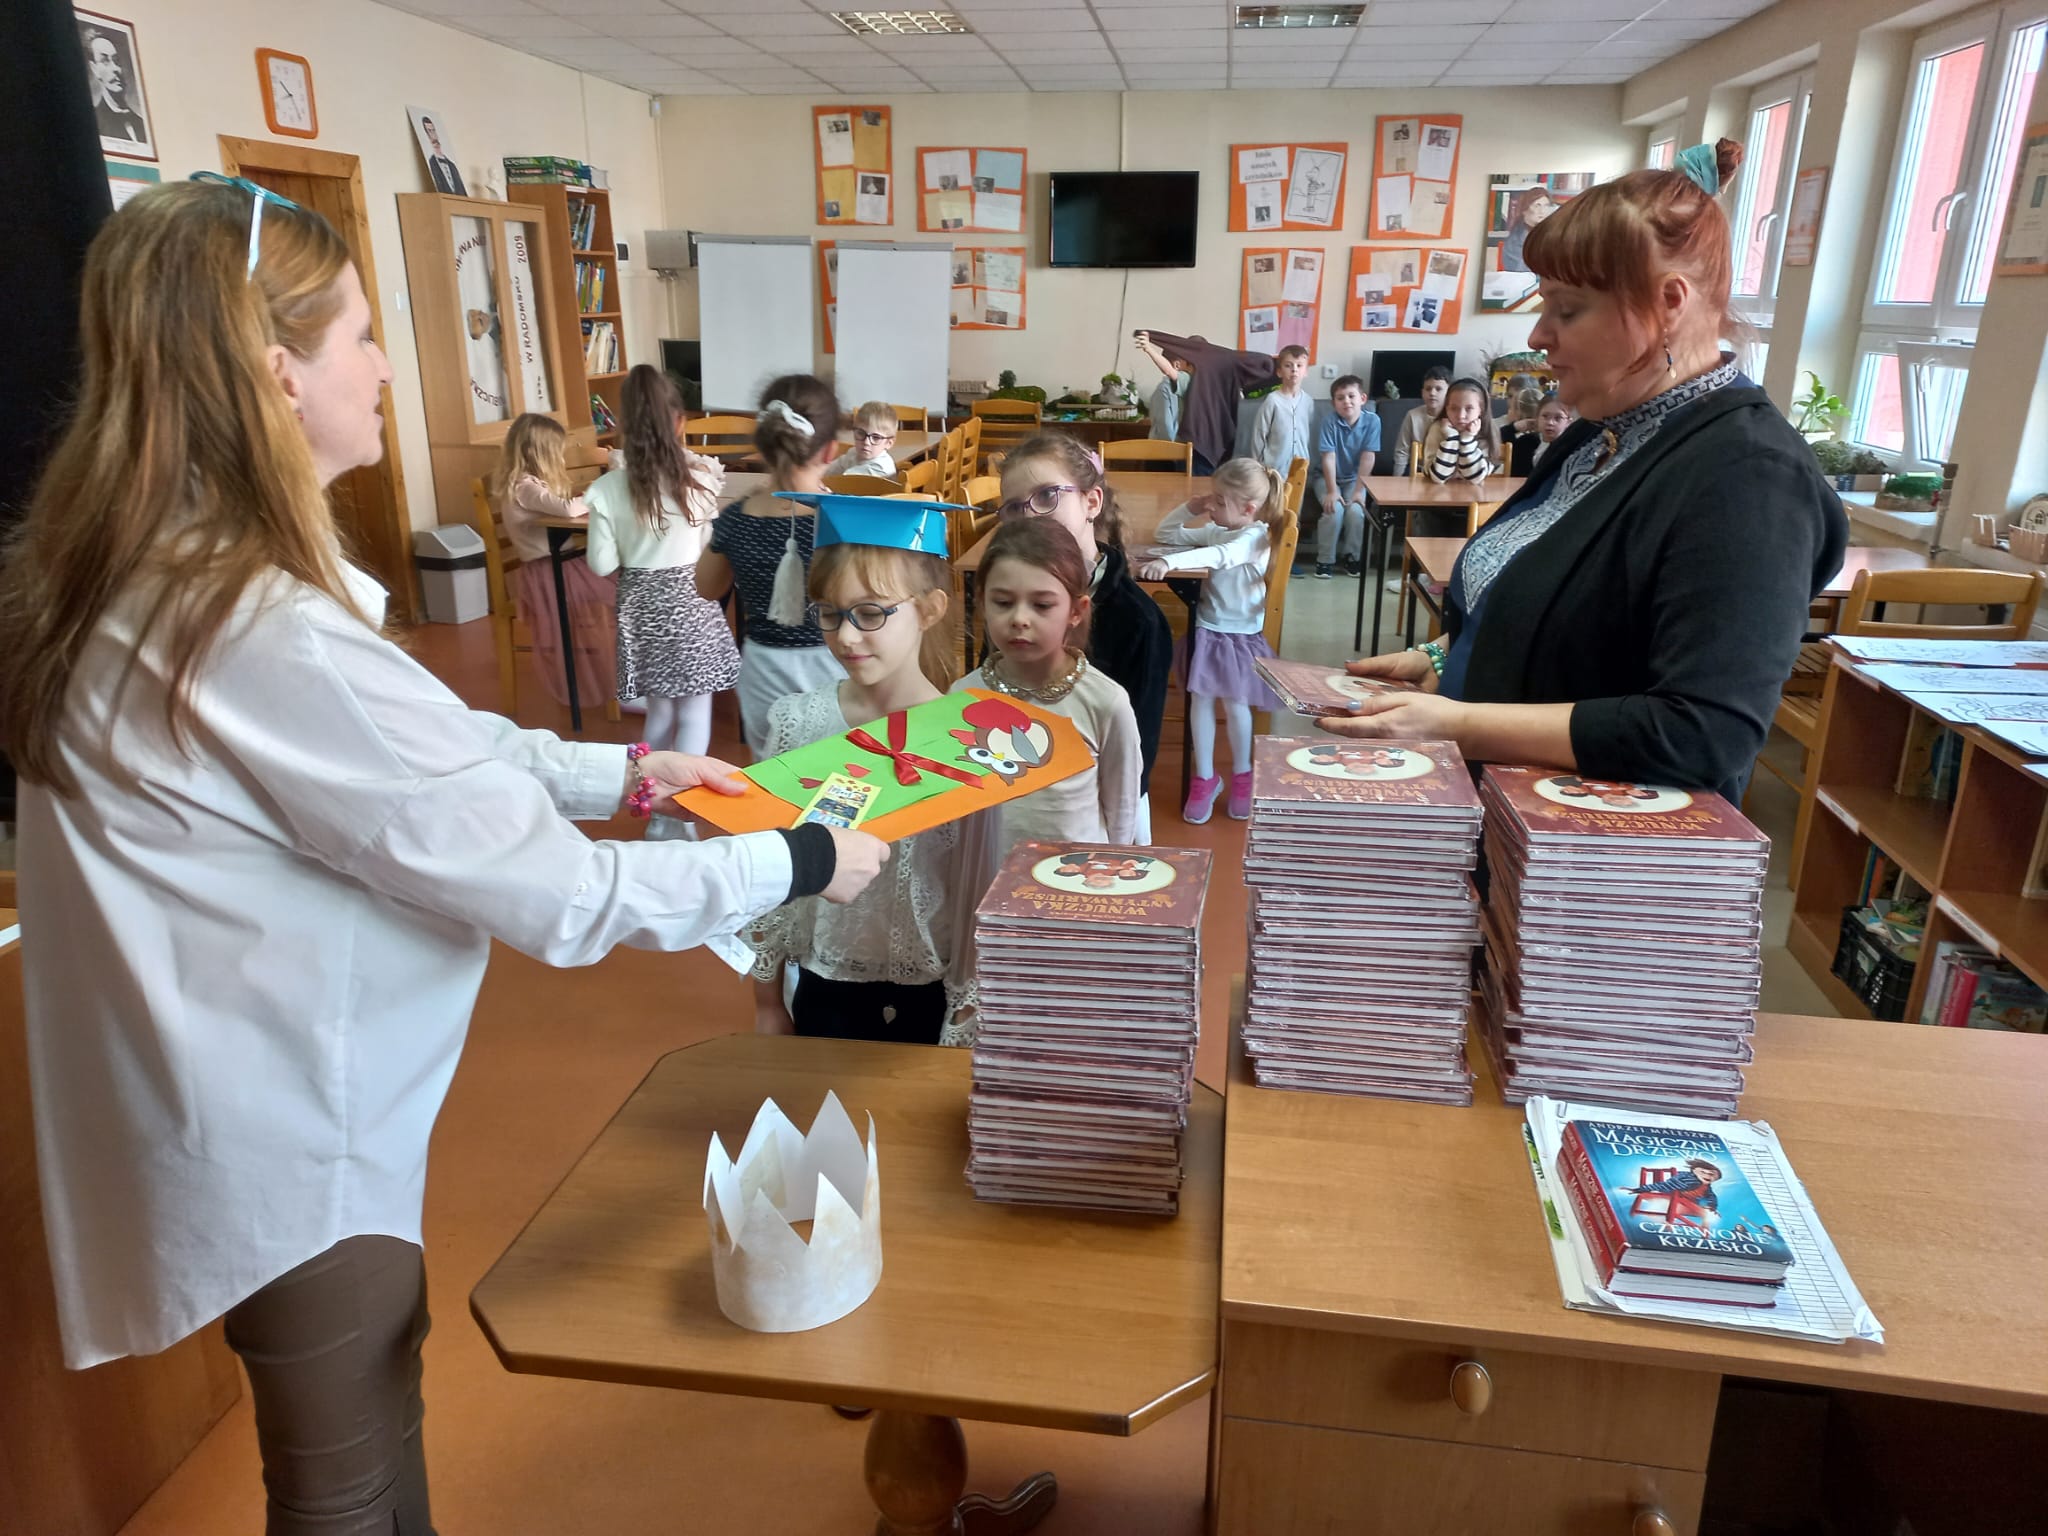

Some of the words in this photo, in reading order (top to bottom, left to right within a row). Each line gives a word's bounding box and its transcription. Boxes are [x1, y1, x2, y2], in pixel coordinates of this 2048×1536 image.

[514, 235, 527, 263] 2009
[1012, 891, 1176, 908] ANTYKWARIUSZA
[1033, 901, 1148, 915] WNUCZKA
[1588, 1122, 1645, 1133] ANDRZEJ
[1650, 1128, 1717, 1140] MALESZKA
[1590, 1127, 1725, 1153] MAGICZNE
[1607, 1141, 1718, 1161] DRZEWO
[1638, 1221, 1771, 1245] CZERWONE
[1658, 1234, 1763, 1255] KRZESŁO
